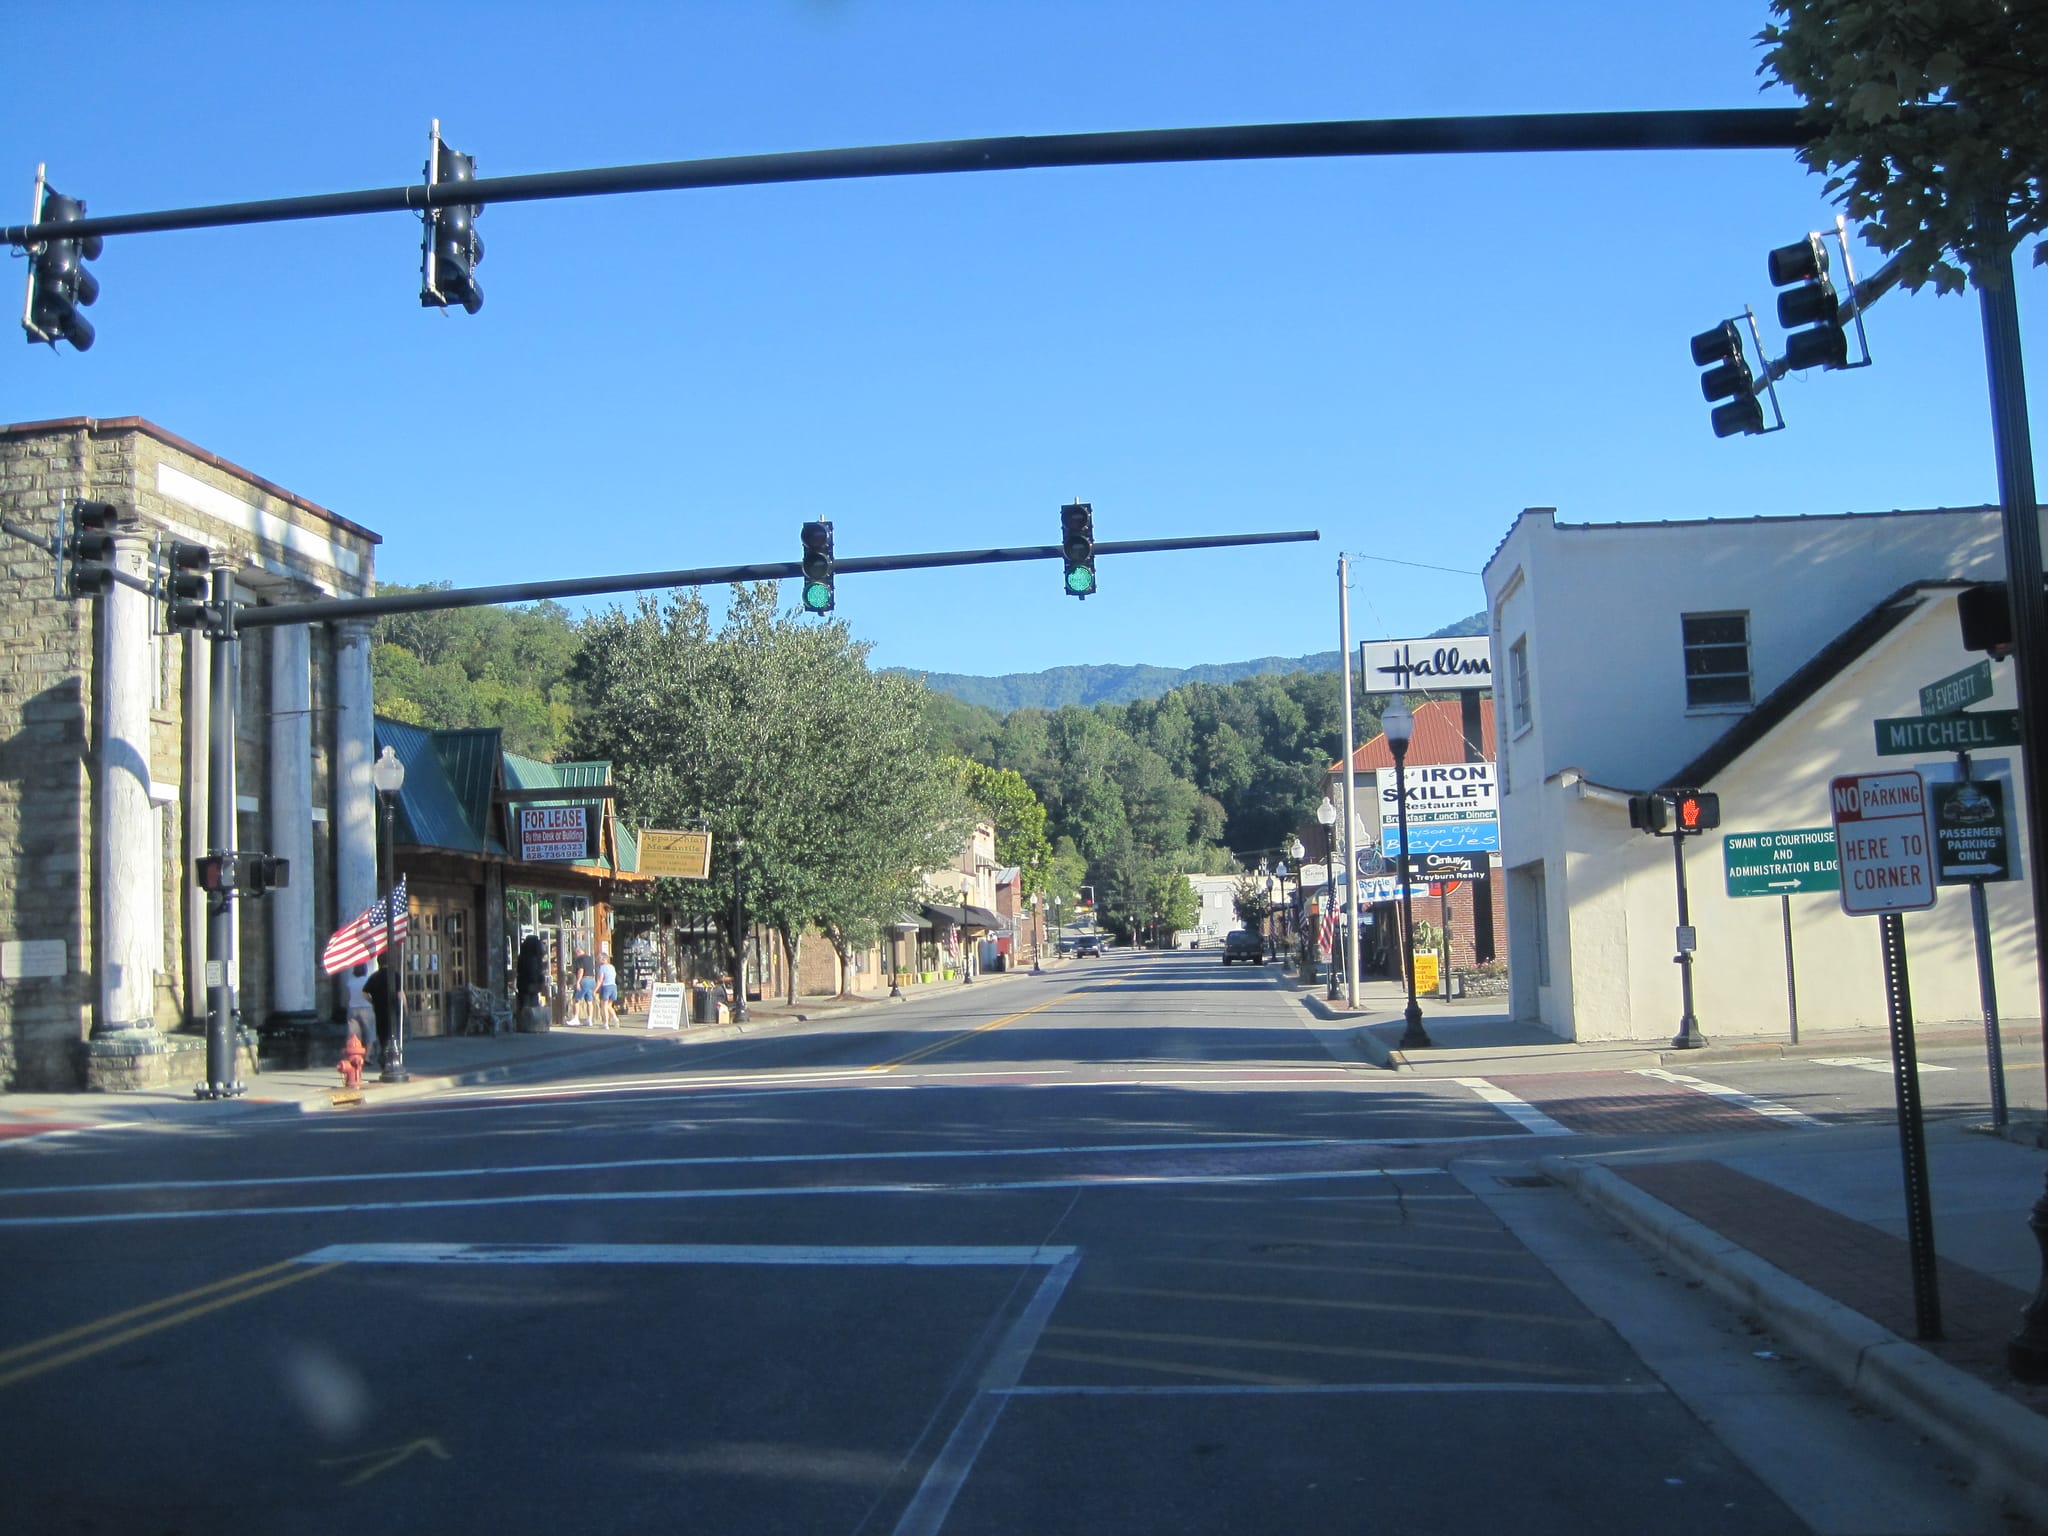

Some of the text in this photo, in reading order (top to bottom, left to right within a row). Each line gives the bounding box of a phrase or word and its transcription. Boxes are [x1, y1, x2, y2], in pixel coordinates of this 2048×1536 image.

[1376, 644, 1491, 690] Hallm
[1936, 673, 1975, 710] EVERETT
[1889, 716, 2020, 748] MITCHELL S
[1421, 766, 1487, 783] IRON
[1382, 783, 1494, 802] SKILLET
[1833, 785, 1920, 813] NO PARKING
[525, 810, 582, 829] FOR LEASE
[1385, 813, 1427, 824] Brekfast
[1434, 811, 1459, 821] Lunch
[1466, 810, 1494, 820] Dinner
[1407, 828, 1447, 838] ryson
[1729, 832, 1835, 850] SWAIN CO COURTHOUSE
[1939, 826, 2002, 839] PASSENGER
[1386, 835, 1496, 852] Bcycles
[1845, 834, 1922, 862] HERE TO
[1947, 838, 1996, 850] PARKING
[1427, 855, 1472, 871] Century 21
[1773, 849, 1793, 861] AND
[1958, 850, 1987, 861] ONLY
[1415, 872, 1486, 882] Treyburn Realty
[1729, 862, 1810, 878] ADMINISTRATION
[1854, 864, 1922, 891] CORNER
